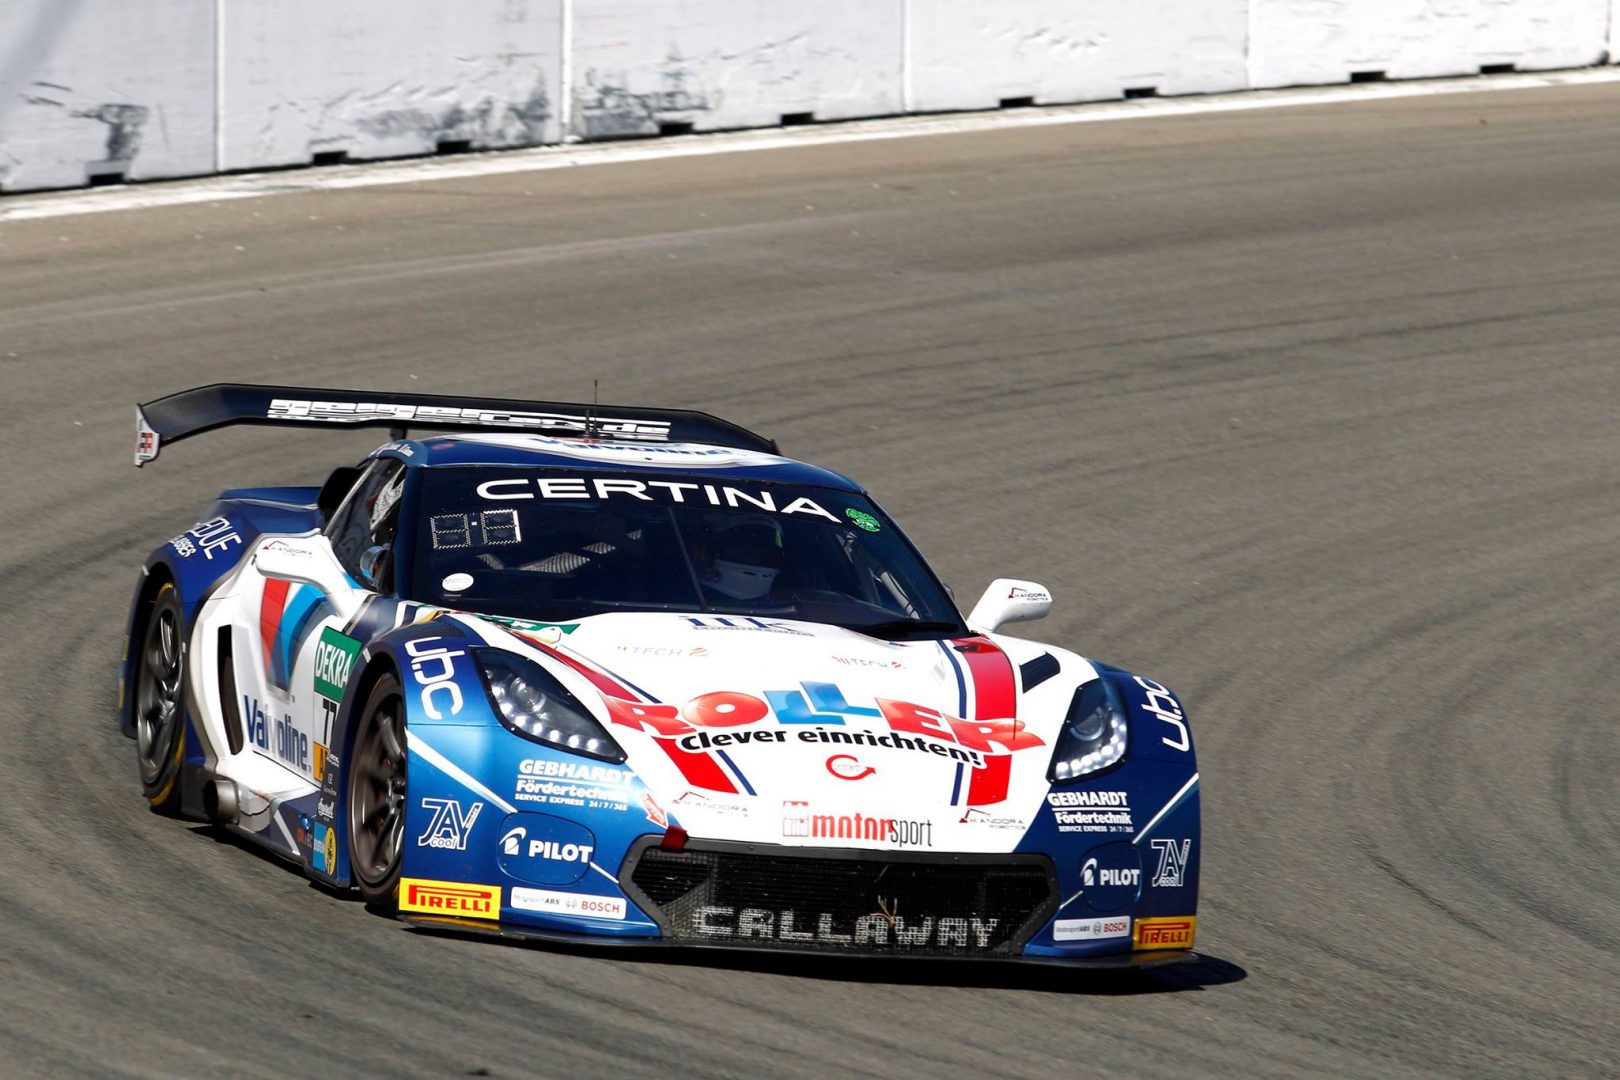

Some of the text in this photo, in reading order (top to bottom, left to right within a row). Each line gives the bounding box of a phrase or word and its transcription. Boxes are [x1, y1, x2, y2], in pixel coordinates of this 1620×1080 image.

[476, 478, 843, 524] CERTINA
[315, 641, 353, 688] DEKRA
[597, 681, 1046, 753] ROLLER
[798, 729, 982, 766] einrichten!
[519, 759, 637, 785] GEBHARDT
[514, 793, 548, 804] SERVICE
[549, 796, 585, 807] EXPRESS
[1047, 791, 1128, 807] GEBHARDT
[1055, 811, 1133, 825] Fördertechnik
[528, 839, 594, 864] PILOT
[1100, 869, 1141, 886] PILOT
[408, 884, 493, 913] PIRELLI
[581, 900, 621, 914] BOSCH
[692, 904, 1001, 949] CALLAWAY
[1103, 922, 1128, 933] BOSCH
[1138, 921, 1192, 945] PIRELLI
